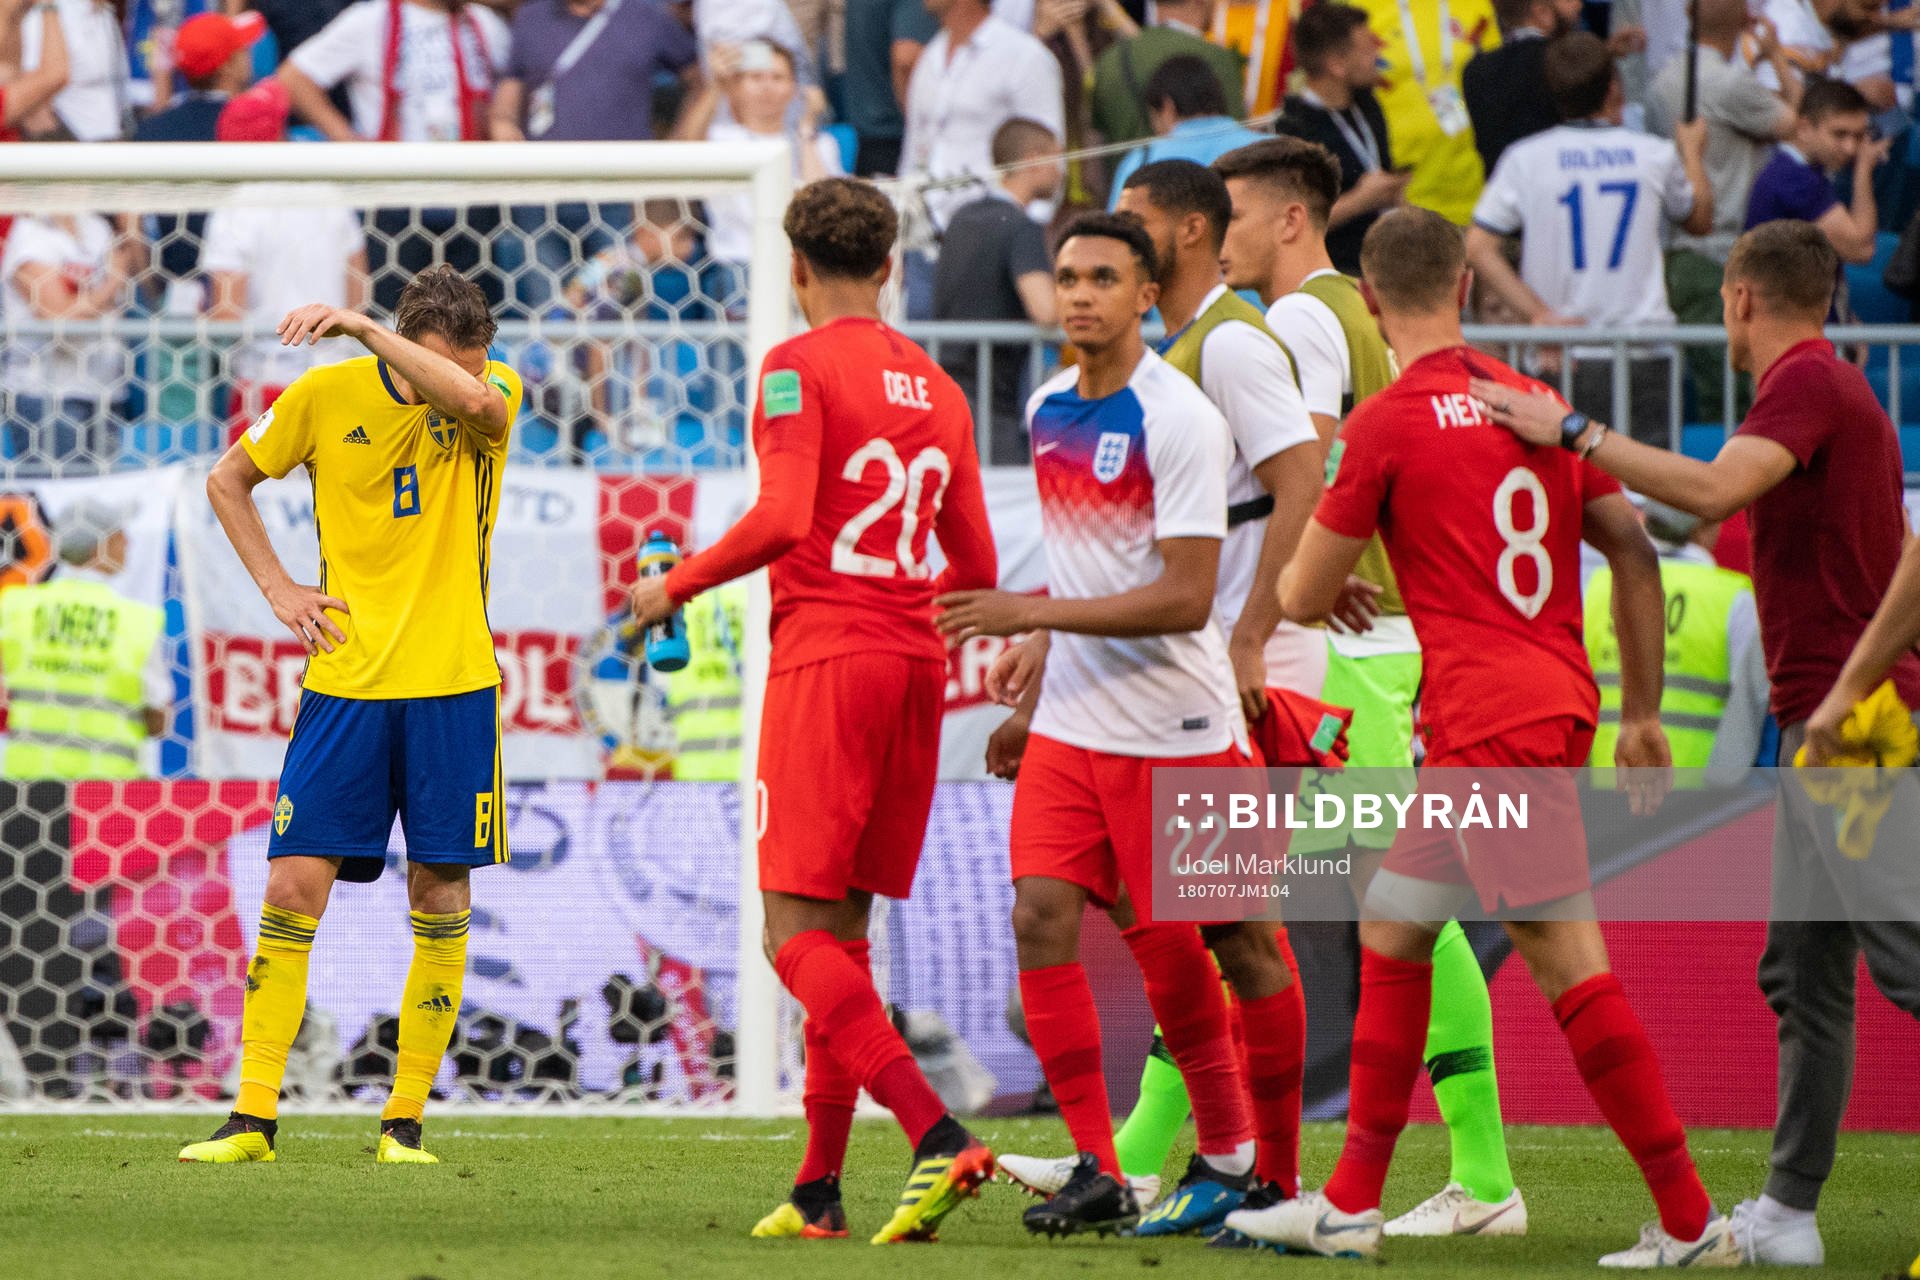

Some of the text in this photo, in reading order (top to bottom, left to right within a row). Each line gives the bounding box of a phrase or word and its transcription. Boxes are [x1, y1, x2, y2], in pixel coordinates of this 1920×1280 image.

[1558, 181, 1639, 270] 17
[883, 369, 933, 411] DELE
[342, 436, 371, 446] adidas
[393, 463, 421, 519] 8
[831, 437, 951, 580] 20
[1493, 466, 1553, 620] 8
[474, 792, 493, 848] 8
[1165, 811, 1230, 876] 22
